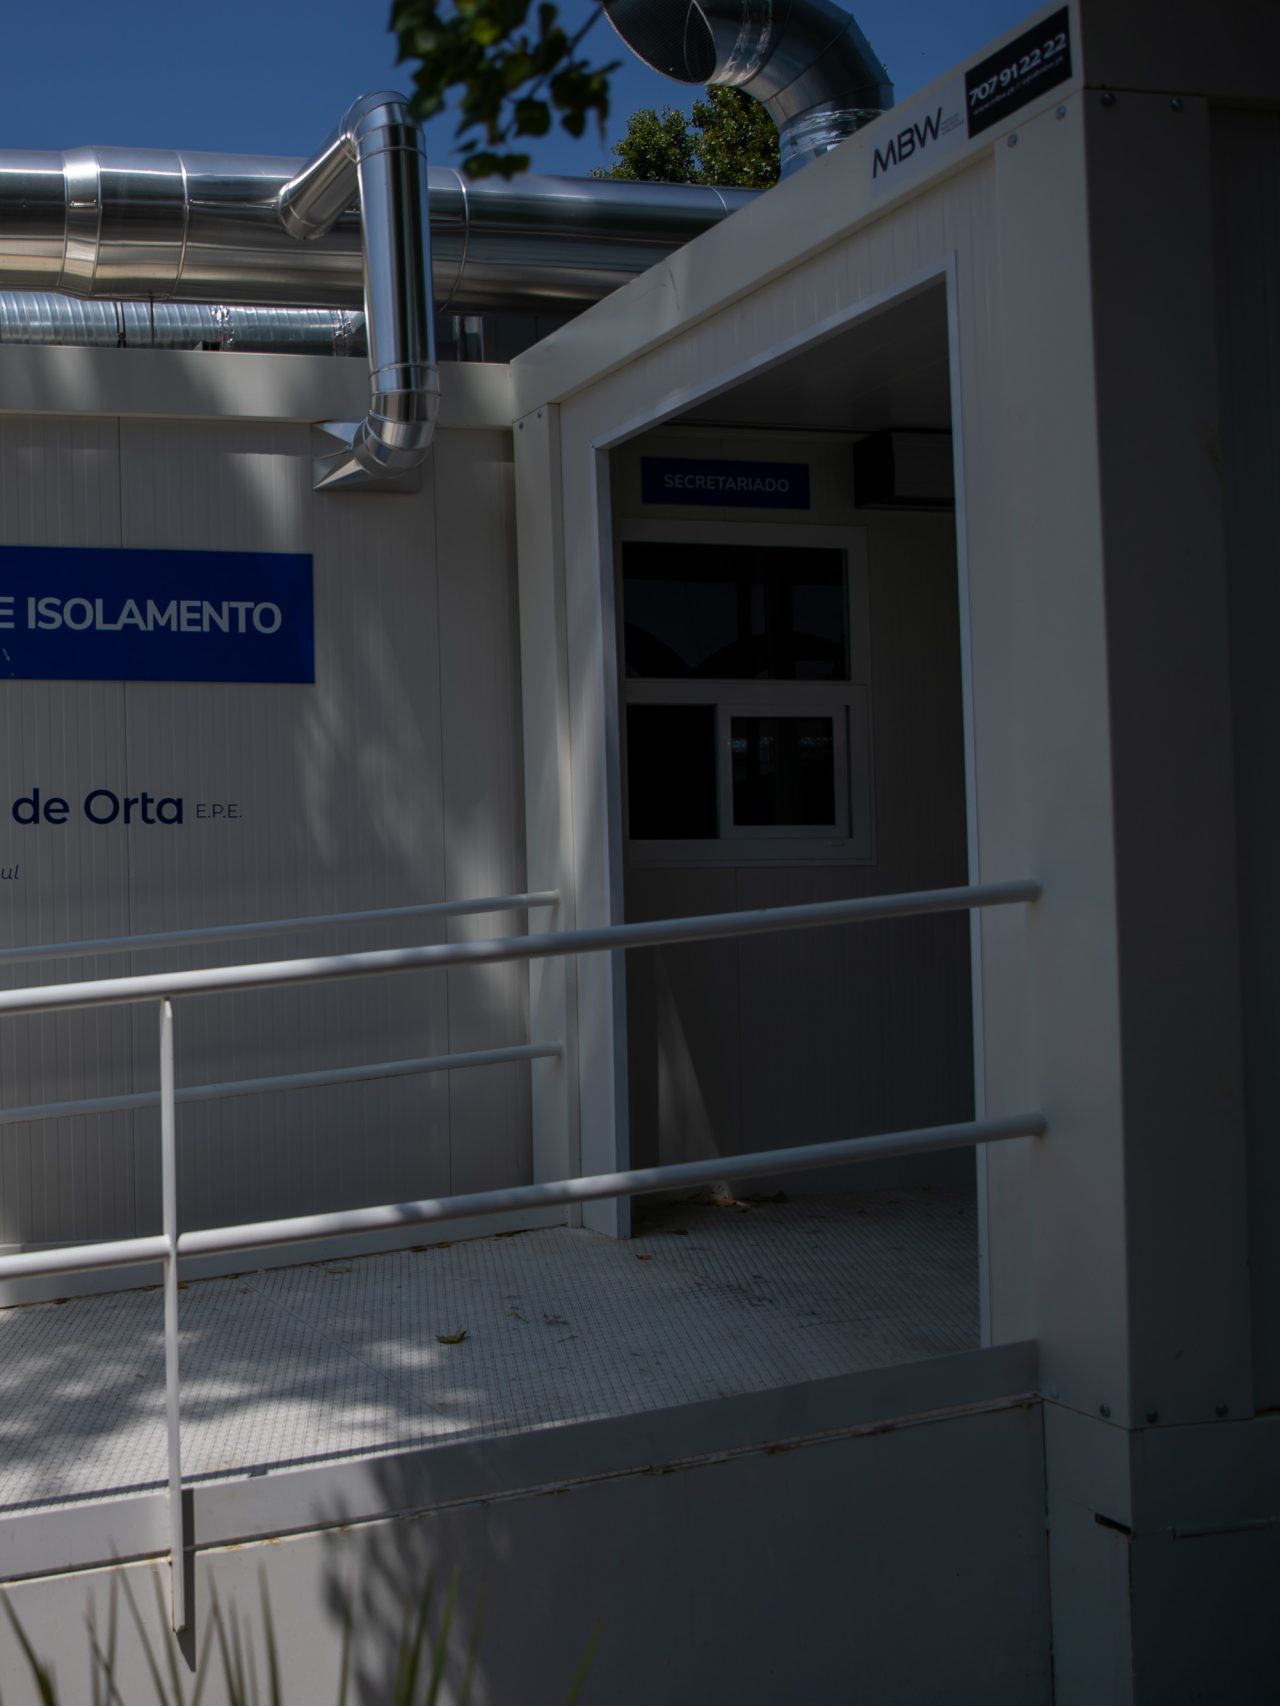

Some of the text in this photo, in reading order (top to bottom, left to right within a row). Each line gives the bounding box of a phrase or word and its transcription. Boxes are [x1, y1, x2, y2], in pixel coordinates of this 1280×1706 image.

[968, 75, 998, 105] 707
[1000, 63, 1018, 87] 91
[1020, 48, 1042, 75] 22
[1043, 32, 1068, 60] 22
[872, 106, 943, 179] MBW
[663, 473, 790, 493] SECRETARIADO
[27, 597, 283, 635] ISOLAMENTO
[11, 787, 70, 825] de
[83, 788, 185, 826] Orta
[195, 802, 243, 820] E.P.E.
